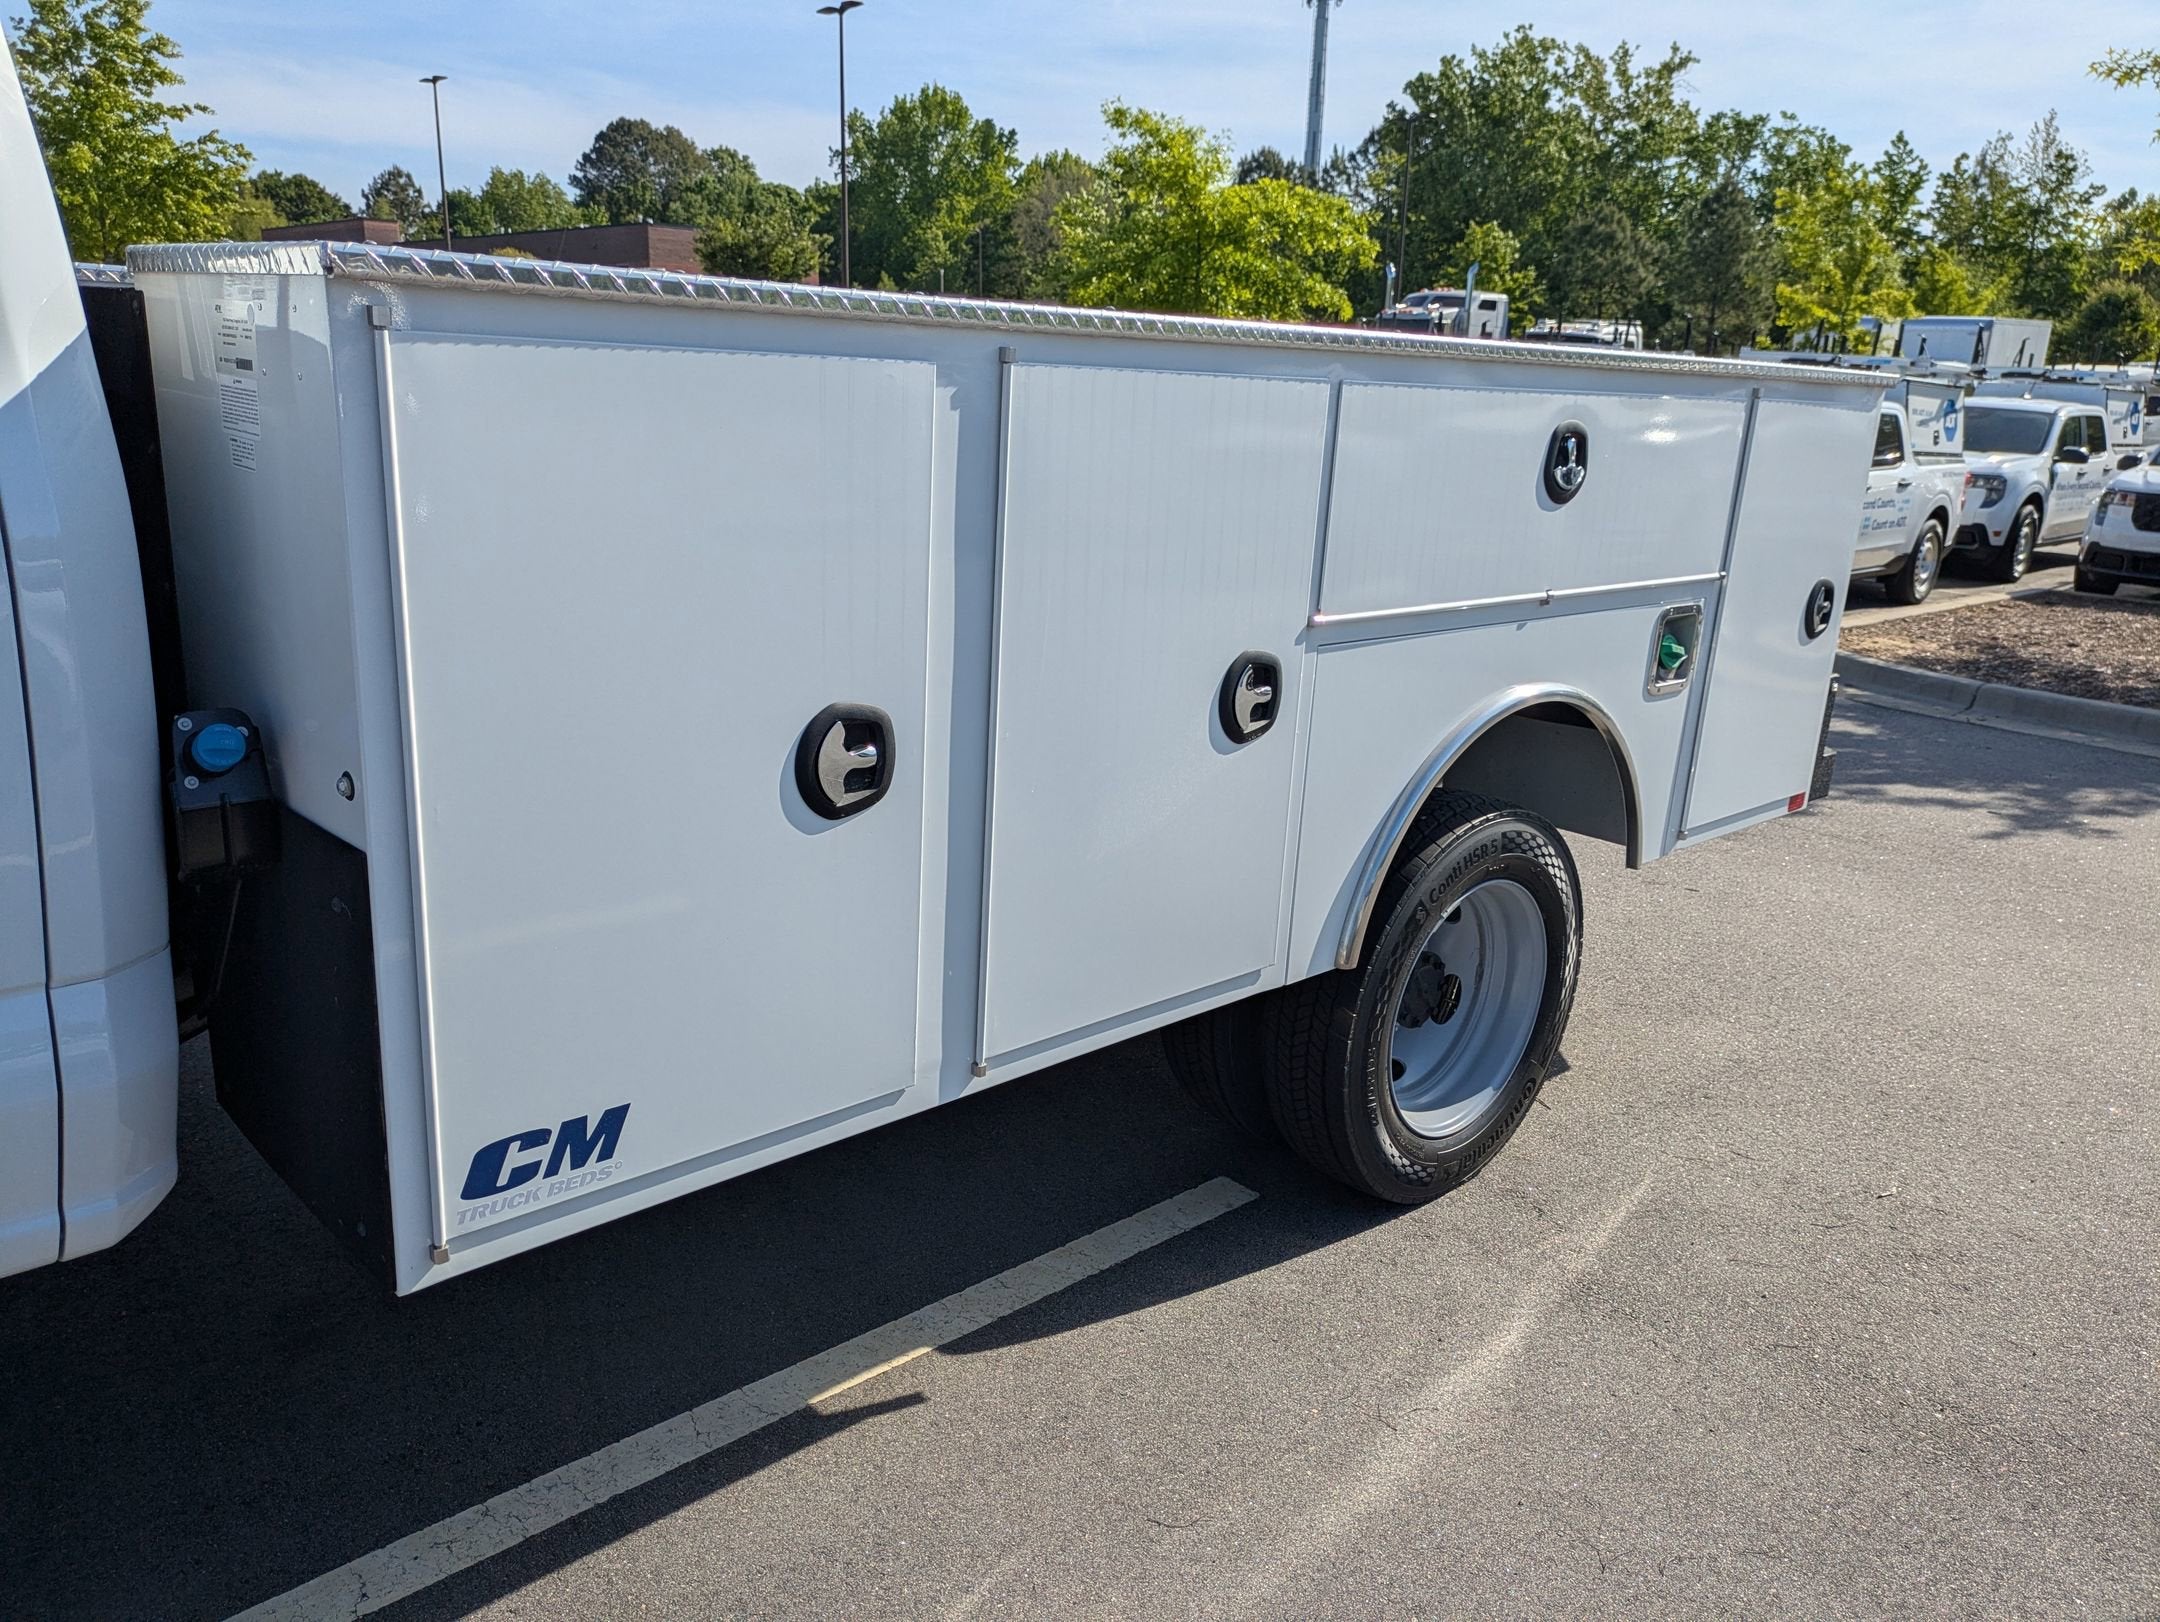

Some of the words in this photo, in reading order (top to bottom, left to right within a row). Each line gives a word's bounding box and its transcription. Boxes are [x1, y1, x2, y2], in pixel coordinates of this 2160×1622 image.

[1429, 861, 1462, 904] Conti
[1463, 843, 1488, 870] HSR
[1490, 838, 1499, 855] 5
[460, 1102, 631, 1200] CM
[456, 1187, 543, 1226] TRUCK
